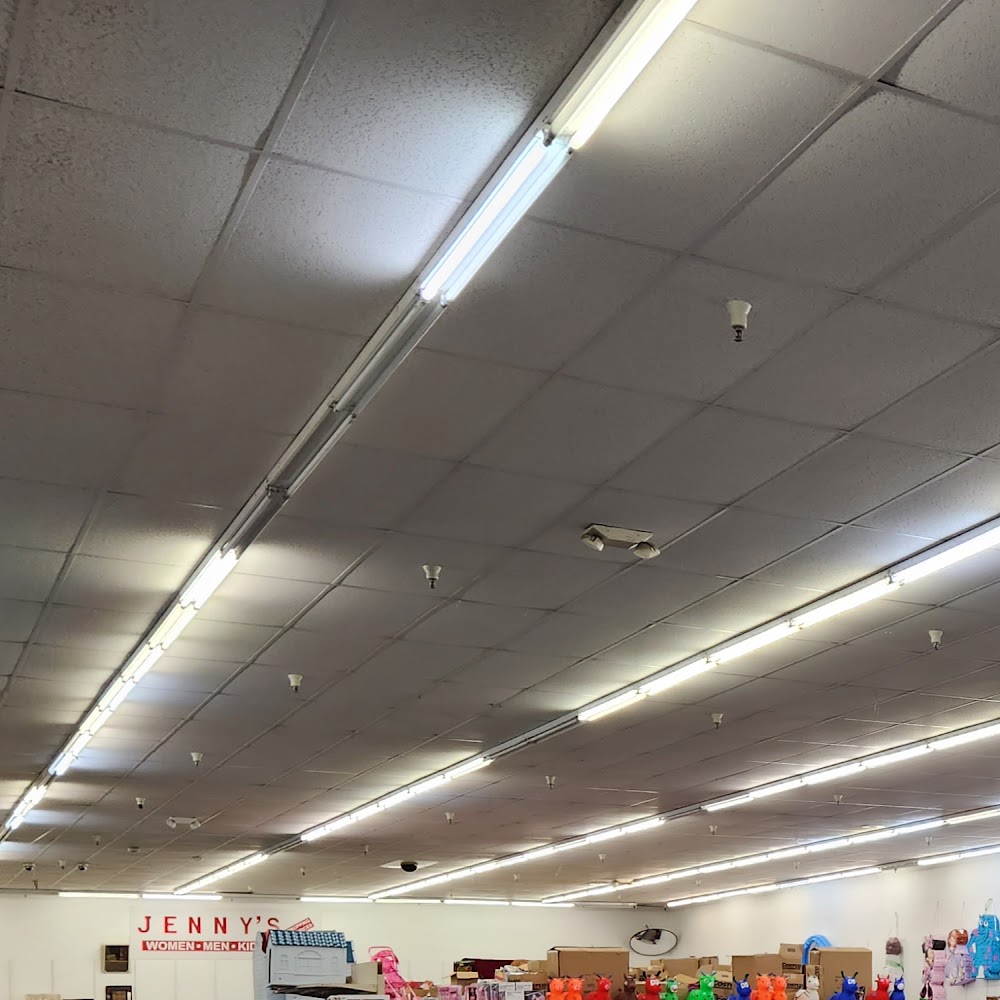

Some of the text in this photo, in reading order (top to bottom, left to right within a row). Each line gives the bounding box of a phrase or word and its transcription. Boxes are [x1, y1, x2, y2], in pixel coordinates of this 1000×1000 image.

[137, 915, 280, 934] JENNY'S
[145, 941, 195, 951] WOMEN
[203, 941, 230, 951] MEN
